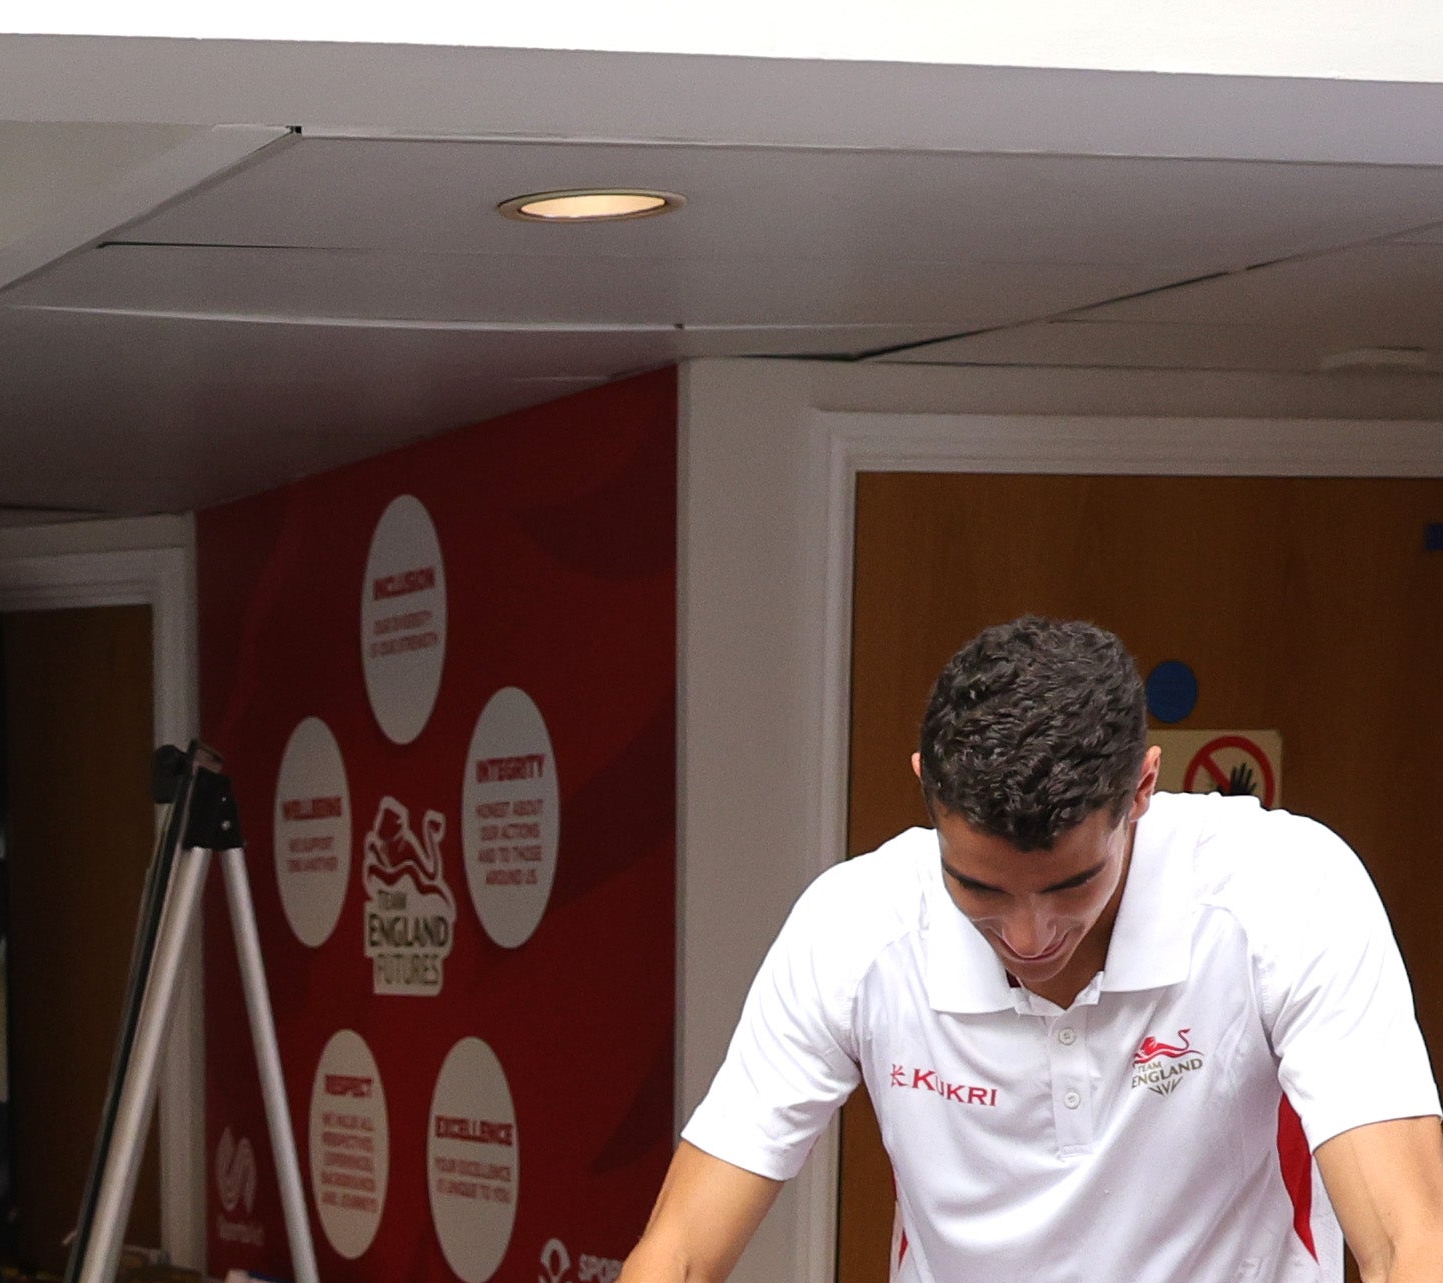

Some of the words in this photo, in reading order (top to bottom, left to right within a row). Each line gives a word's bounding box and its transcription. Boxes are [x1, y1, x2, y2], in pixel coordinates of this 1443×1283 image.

[369, 913, 449, 947] ENGLAND
[912, 1068, 998, 1107] KUKRI
[1132, 1058, 1203, 1089] ENGLAND
